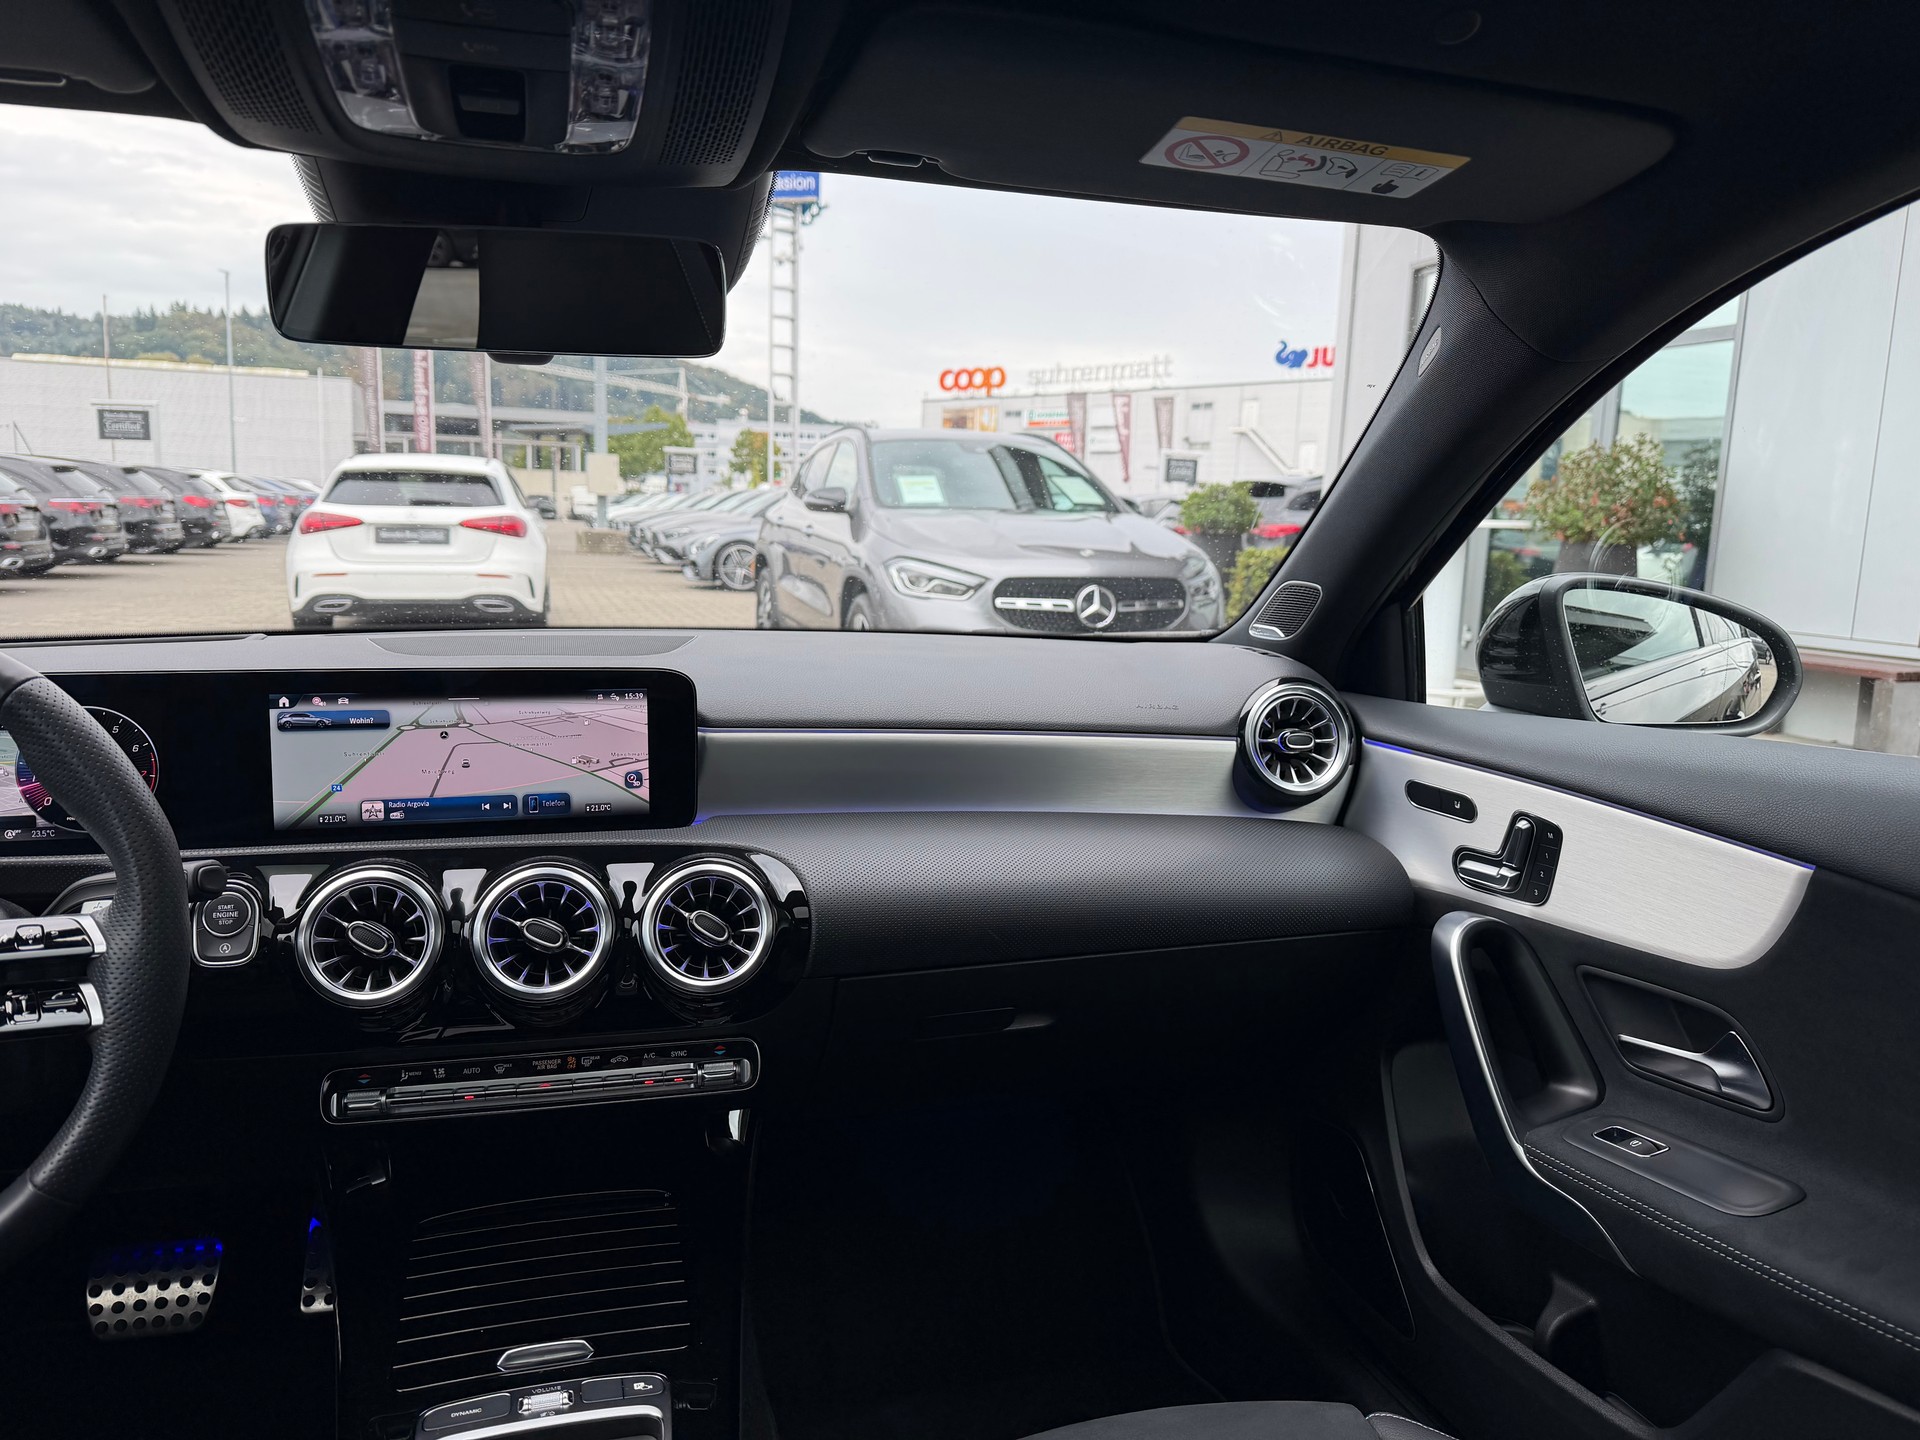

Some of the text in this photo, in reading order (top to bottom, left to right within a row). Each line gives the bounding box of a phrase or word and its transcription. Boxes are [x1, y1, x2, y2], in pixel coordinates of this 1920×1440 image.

[1296, 135, 1388, 156] AIRBAG
[1028, 354, 1175, 386] suhrenmatt
[940, 367, 1006, 397] coop
[624, 692, 644, 700] 15:39
[349, 717, 374, 725] Wohin?
[112, 725, 120, 734] 5
[132, 744, 140, 753] 6
[44, 796, 53, 806] 0
[406, 800, 430, 809] Argovia
[542, 799, 566, 808] Telefon
[590, 804, 611, 812] 21.0°C
[324, 815, 347, 823] 21.0°C
[31, 829, 56, 838] 23.5°C
[1540, 870, 1545, 878] 2
[212, 911, 239, 919] ENGINE
[670, 1050, 688, 1058] SYNC
[532, 1058, 562, 1067] PASSENGER
[463, 1067, 481, 1075] AUTO
[531, 1385, 562, 1394] VOLUME
[450, 1407, 483, 1418] DYNAMIC
